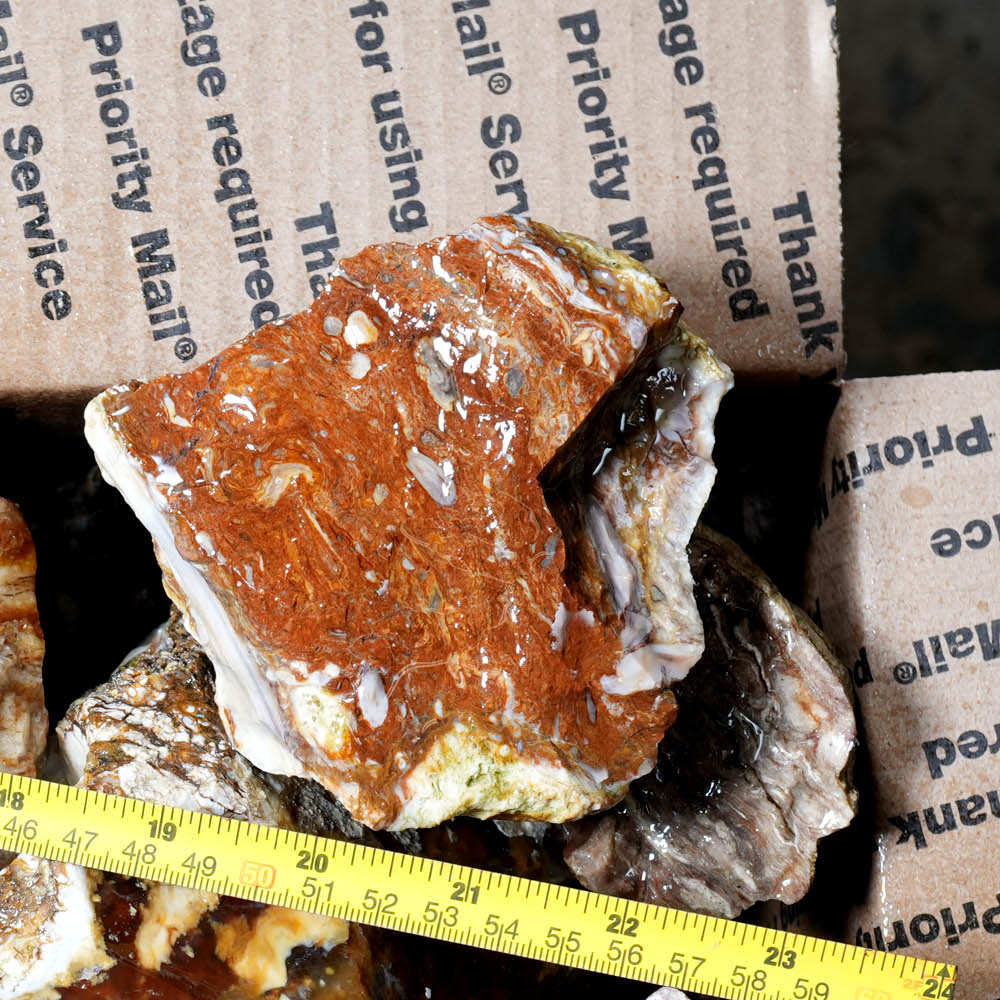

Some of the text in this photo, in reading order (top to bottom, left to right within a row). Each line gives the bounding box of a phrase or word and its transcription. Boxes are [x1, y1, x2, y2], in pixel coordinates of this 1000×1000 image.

[177, 0, 226, 97] age
[350, 0, 428, 233] for using
[559, 9, 631, 203] Priority
[2, 124, 73, 323] Service
[80, 20, 198, 363] Priority Mail®
[684, 101, 770, 323] required
[772, 191, 843, 359] Thank
[3, 816, 38, 841] 46
[62, 828, 99, 851] 47
[122, 840, 157, 864] 48
[181, 852, 217, 877] 49
[301, 876, 334, 901] 51
[362, 889, 398, 914] 52
[422, 901, 459, 927] 53
[484, 914, 520, 940] 54
[545, 927, 582, 953] 55
[607, 939, 643, 966] 56
[669, 952, 706, 978] 57
[730, 965, 767, 991] 58
[148, 819, 177, 842] 19
[296, 850, 329, 873] 20
[450, 881, 481, 905] 21
[606, 914, 640, 938] 22
[764, 946, 798, 970] 23
